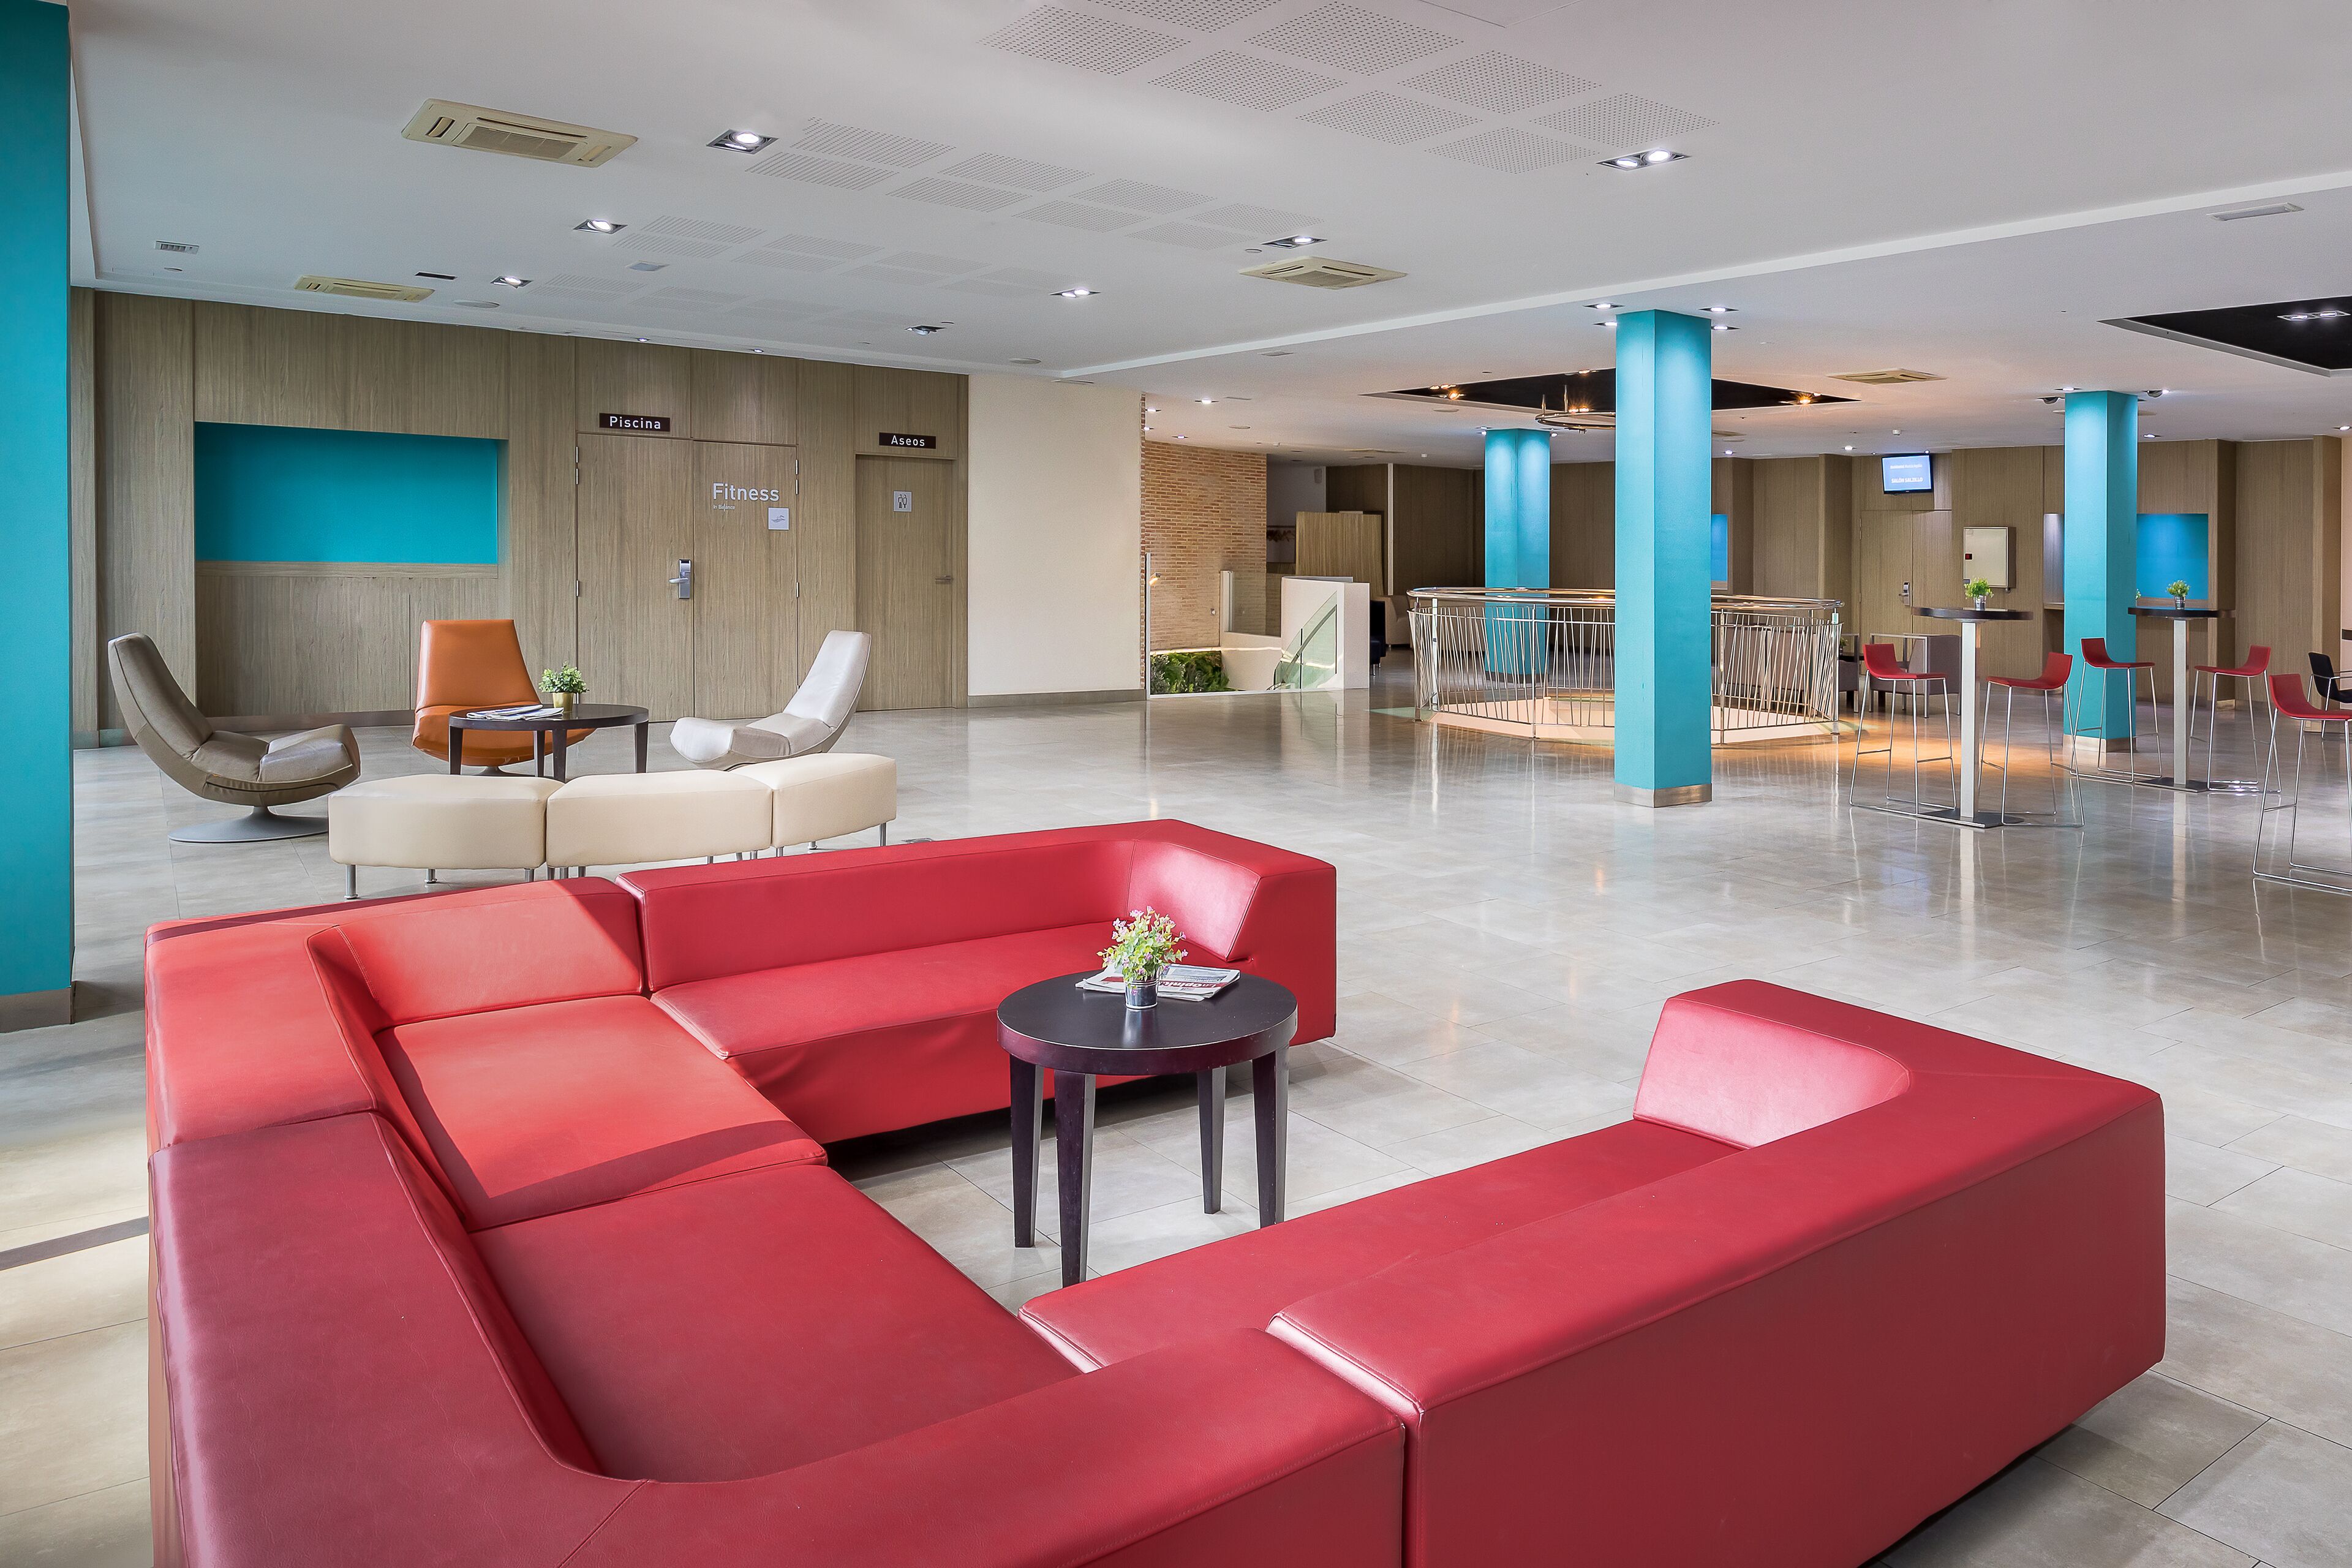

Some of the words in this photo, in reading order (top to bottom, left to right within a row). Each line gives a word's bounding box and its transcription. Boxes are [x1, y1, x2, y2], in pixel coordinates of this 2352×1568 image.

[609, 416, 661, 429] Piscina
[891, 435, 925, 447] Aseos
[713, 482, 780, 502] Fitness
